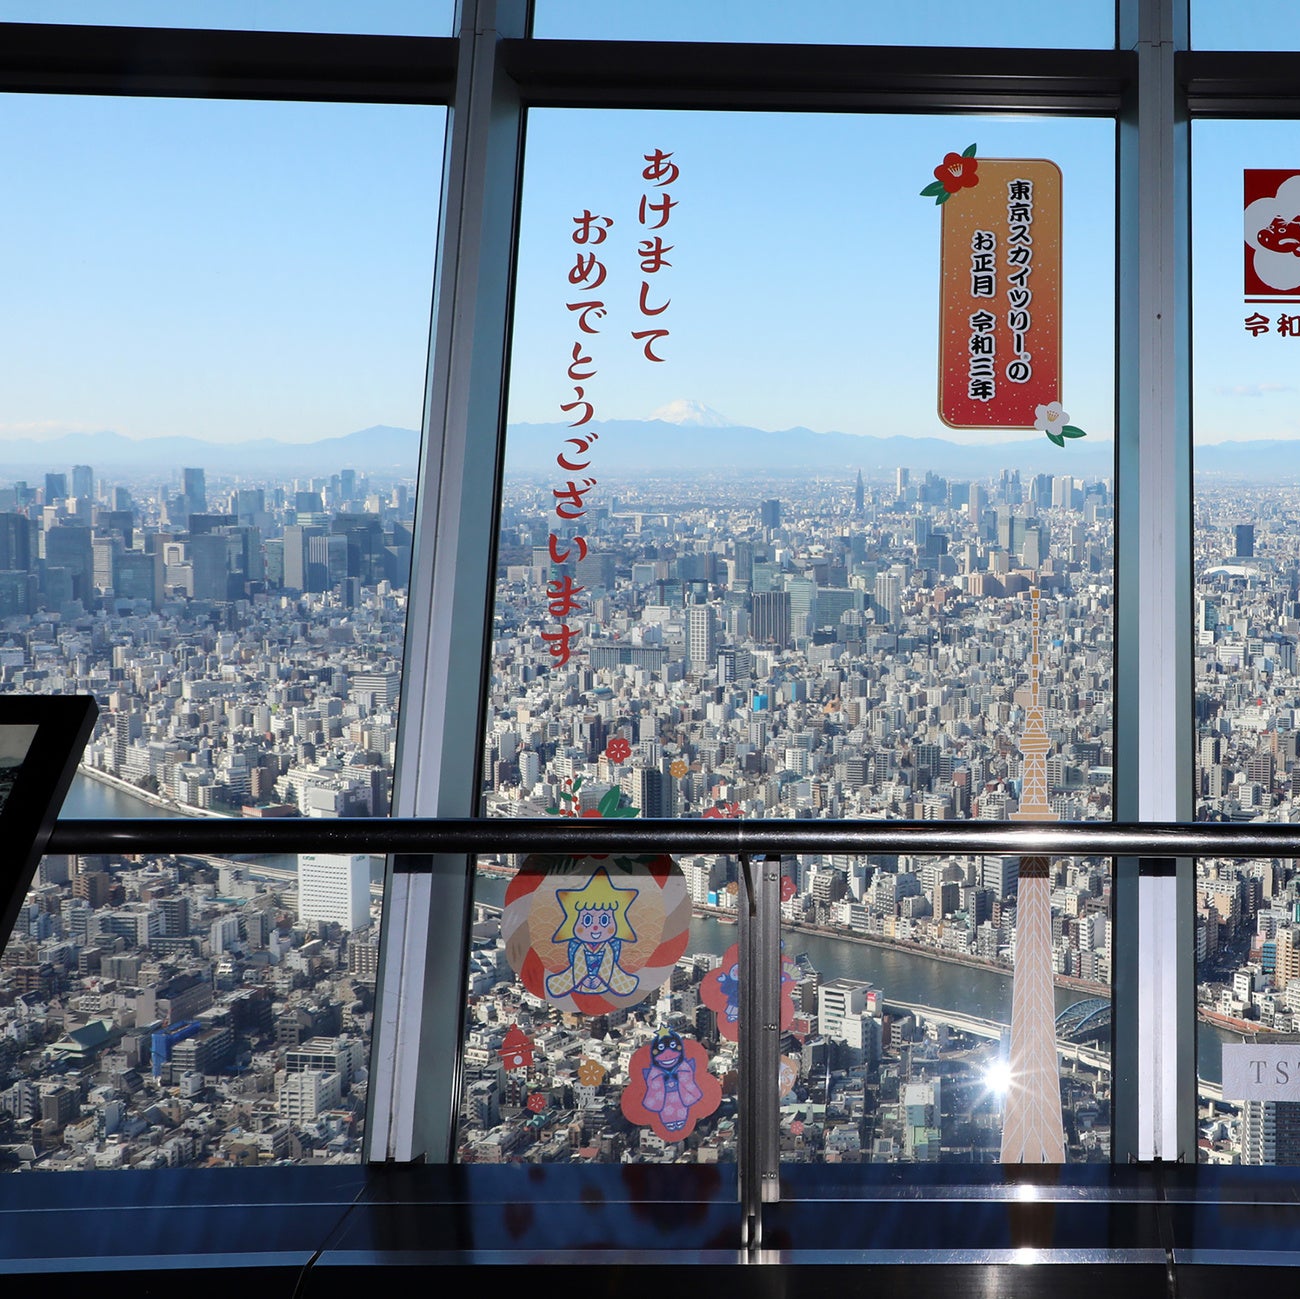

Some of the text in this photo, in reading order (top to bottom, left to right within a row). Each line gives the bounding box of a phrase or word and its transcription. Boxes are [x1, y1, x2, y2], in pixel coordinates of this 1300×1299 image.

[630, 147, 680, 363] あけまして
[970, 231, 995, 400] お正月 令和三年
[540, 209, 615, 669] おめでとうございます
